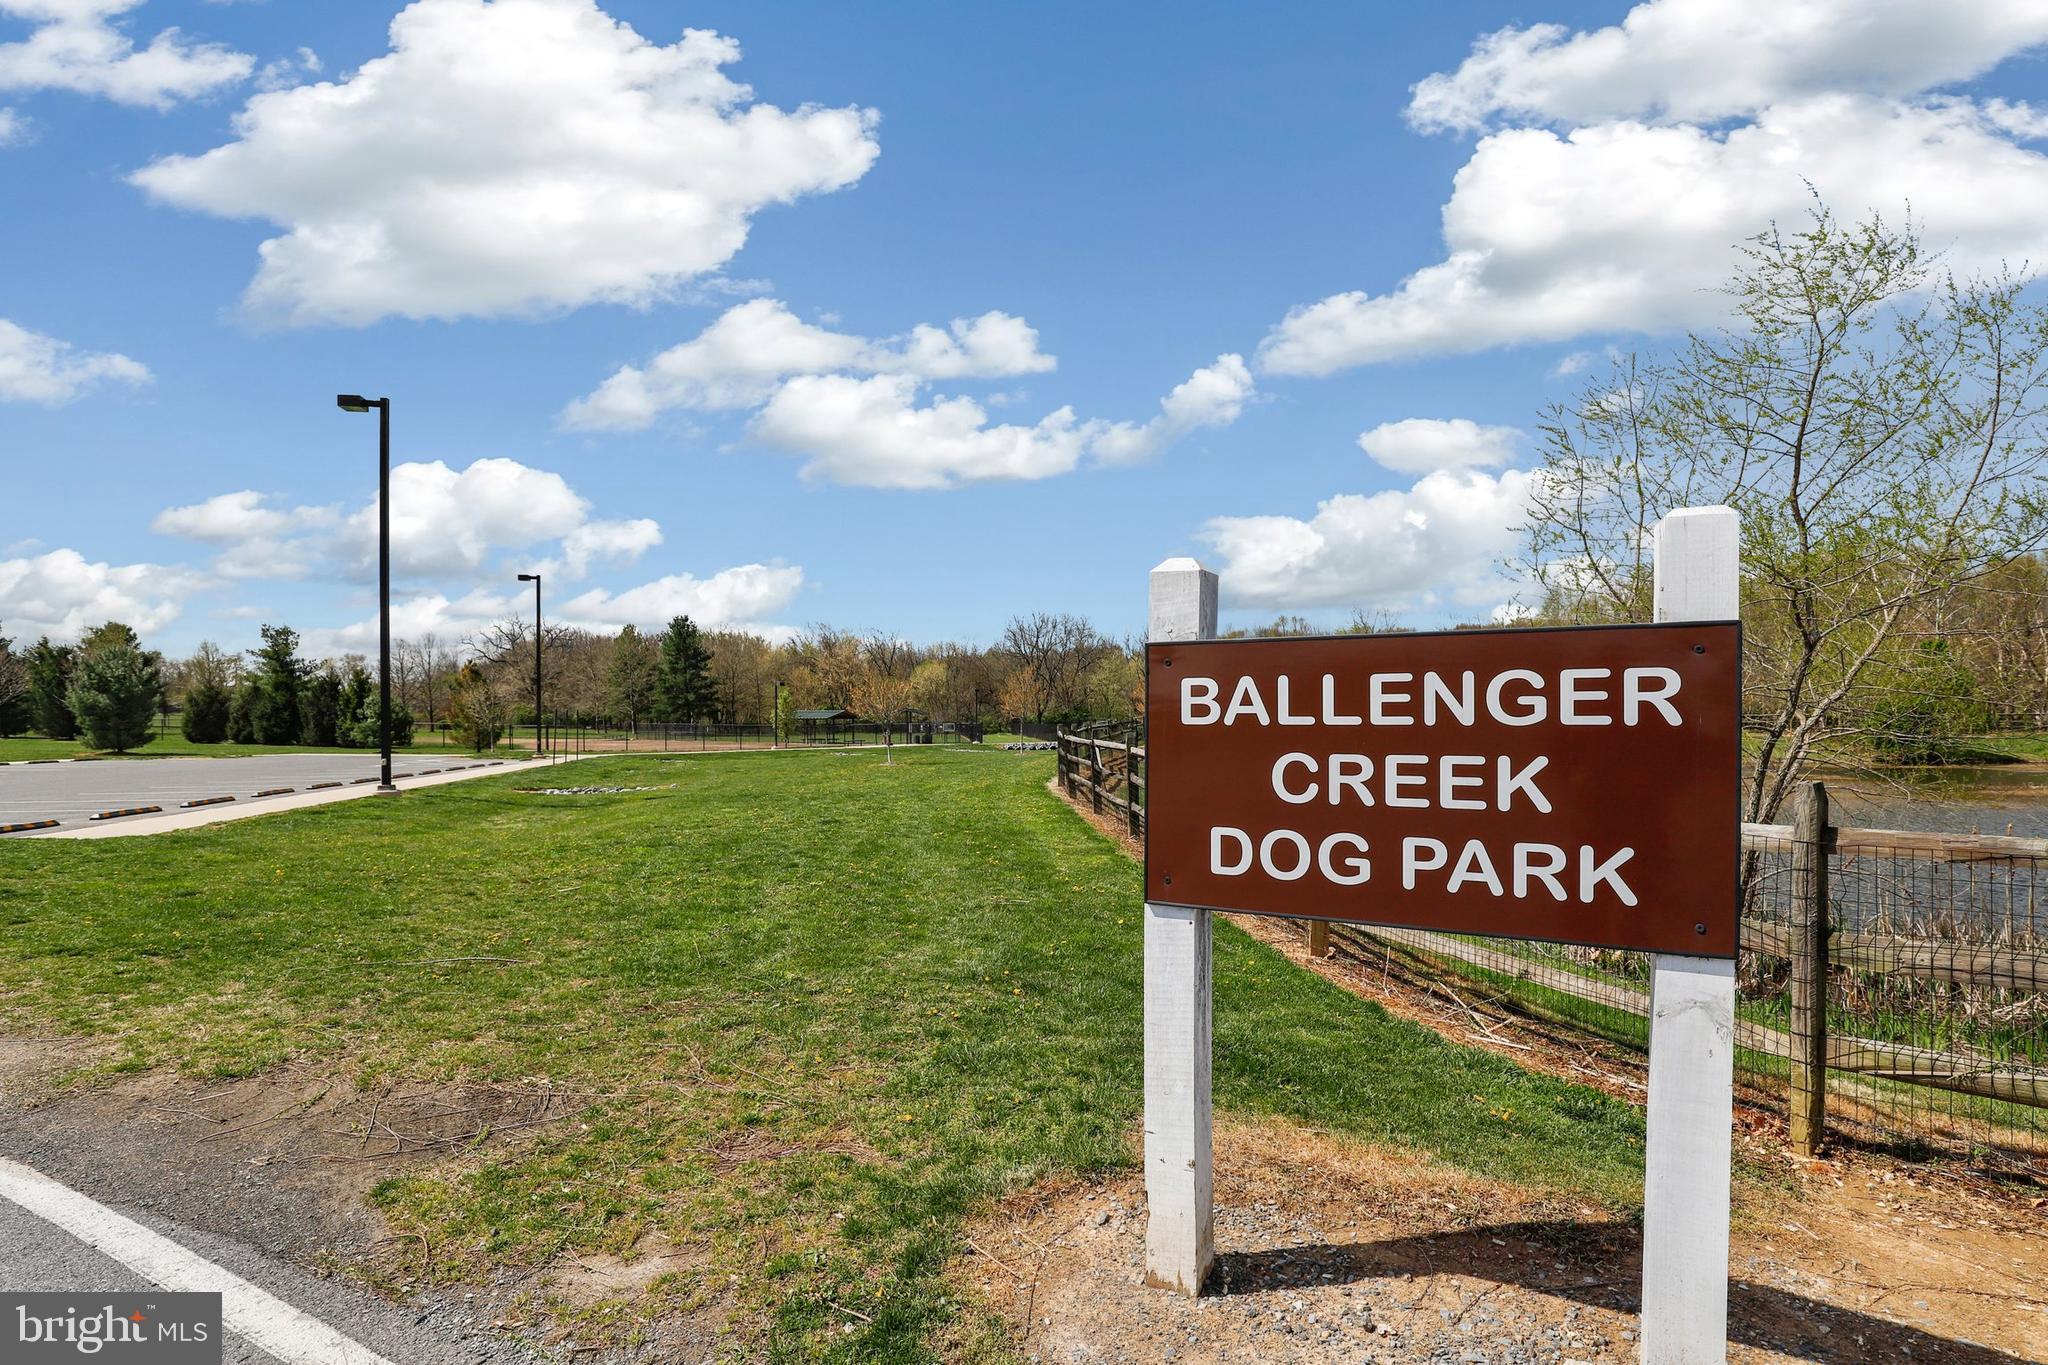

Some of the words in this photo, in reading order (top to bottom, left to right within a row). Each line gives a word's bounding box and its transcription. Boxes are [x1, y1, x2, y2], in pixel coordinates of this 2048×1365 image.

[1180, 667, 1683, 727] BALLENGER
[1271, 752, 1552, 814] CREEK
[1210, 826, 1371, 886] DOG
[1402, 836, 1638, 907] PARK
